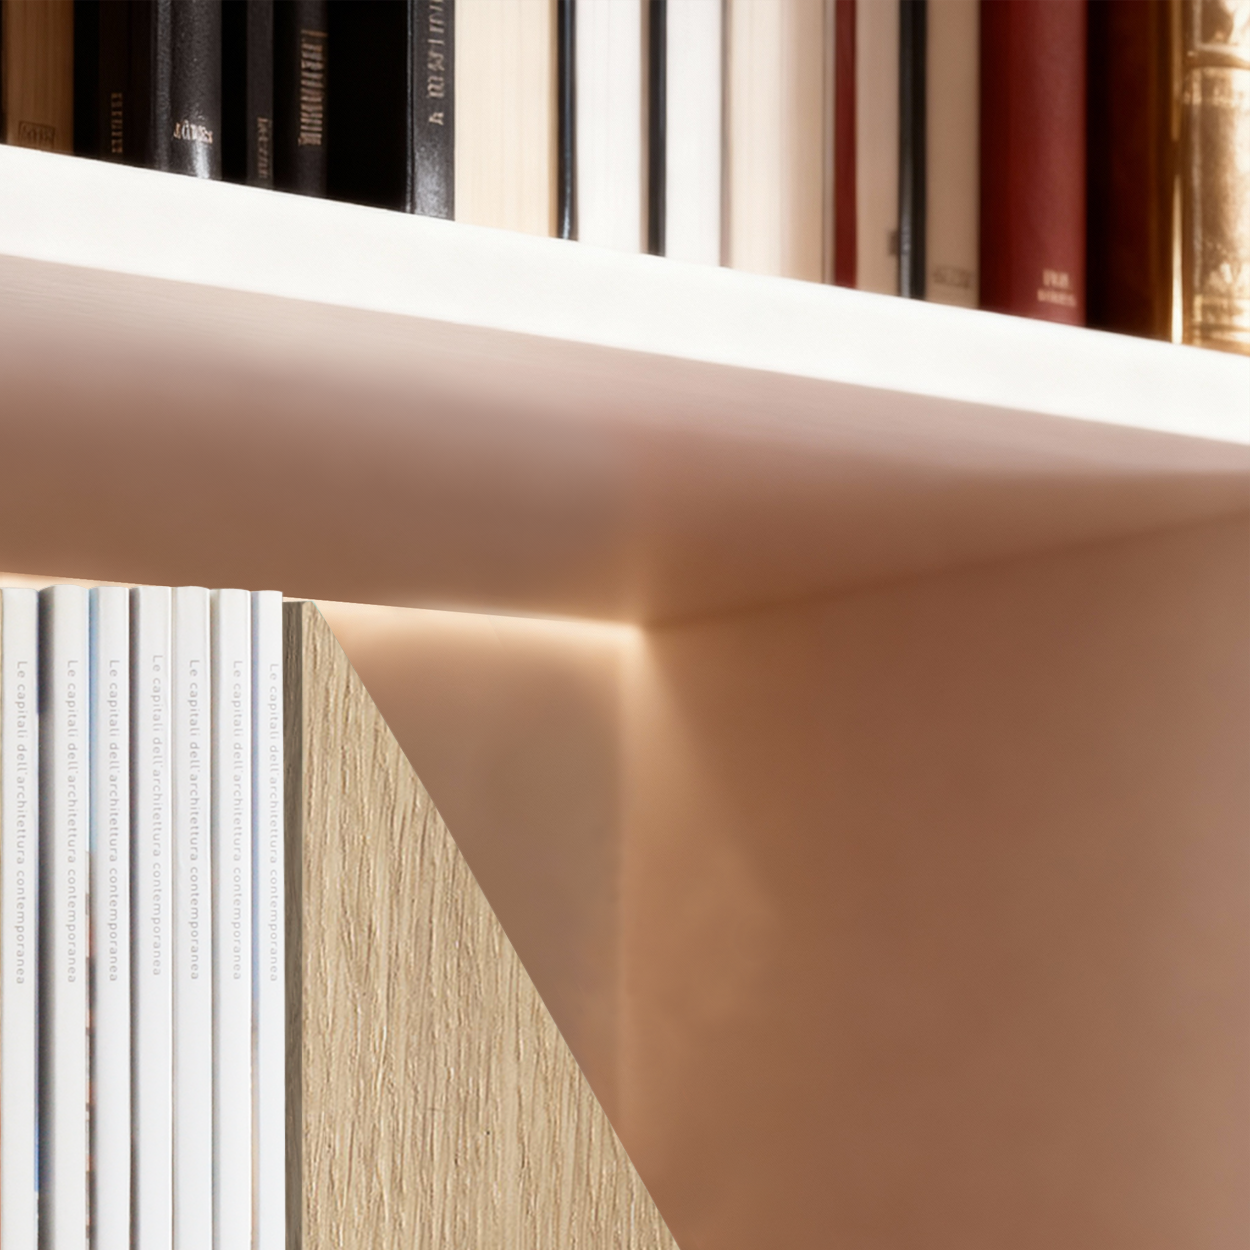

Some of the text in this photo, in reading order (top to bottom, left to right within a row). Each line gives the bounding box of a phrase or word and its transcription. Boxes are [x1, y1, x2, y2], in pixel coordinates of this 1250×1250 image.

[13, 661, 29, 984] Le capitali dell'architettura contemporanea
[64, 660, 79, 982] Le capitali dell'architettura contemporanea
[106, 660, 121, 981] Le capitali dell'architettura contemporanea
[150, 655, 164, 975] Le capitali dell'architettura contemporanea
[186, 660, 201, 979] Le capitali dell'architettura contemporanea
[230, 661, 244, 979] Le capitali dell'architettura contemporanea
[267, 664, 280, 981] Le capitali dell'architettura contemporanea
